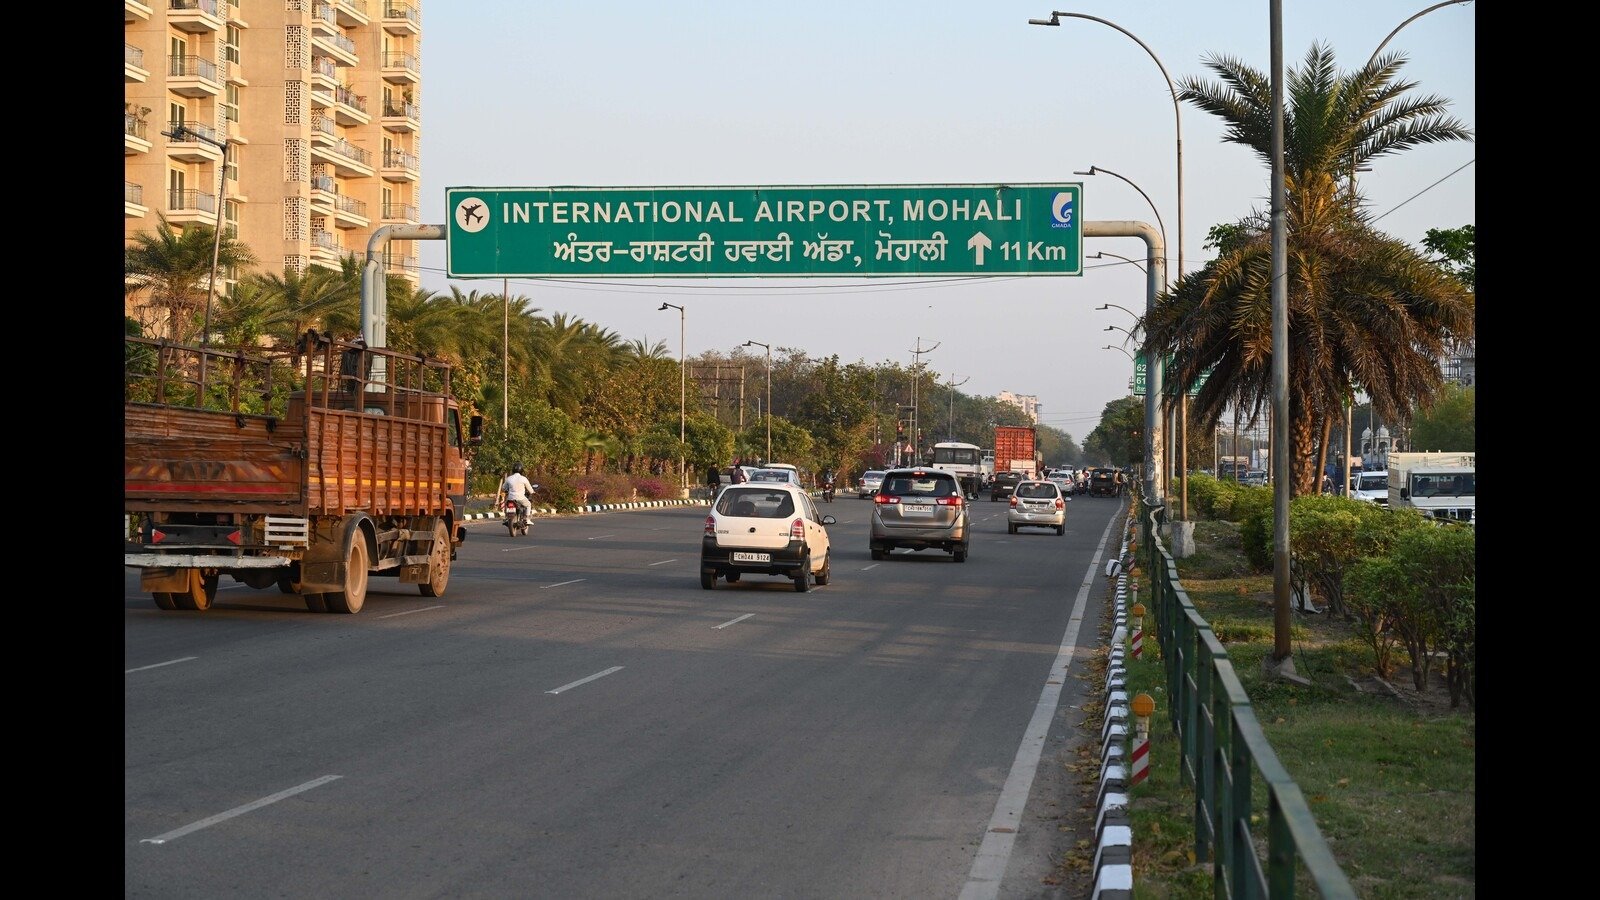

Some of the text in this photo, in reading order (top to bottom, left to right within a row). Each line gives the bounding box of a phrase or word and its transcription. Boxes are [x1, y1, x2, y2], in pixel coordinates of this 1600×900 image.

[503, 198, 1021, 226] INTERNATIONAL AIRPORT, MOHALI
[723, 232, 794, 263] ਹਵਾਈ
[802, 232, 862, 267] ਅੱਡਾ,
[874, 230, 949, 262] ਮੋਹਾਲੀ
[1000, 241, 1066, 261] 11 Km
[1136, 364, 1147, 372] 62
[1136, 377, 1146, 385] 61
